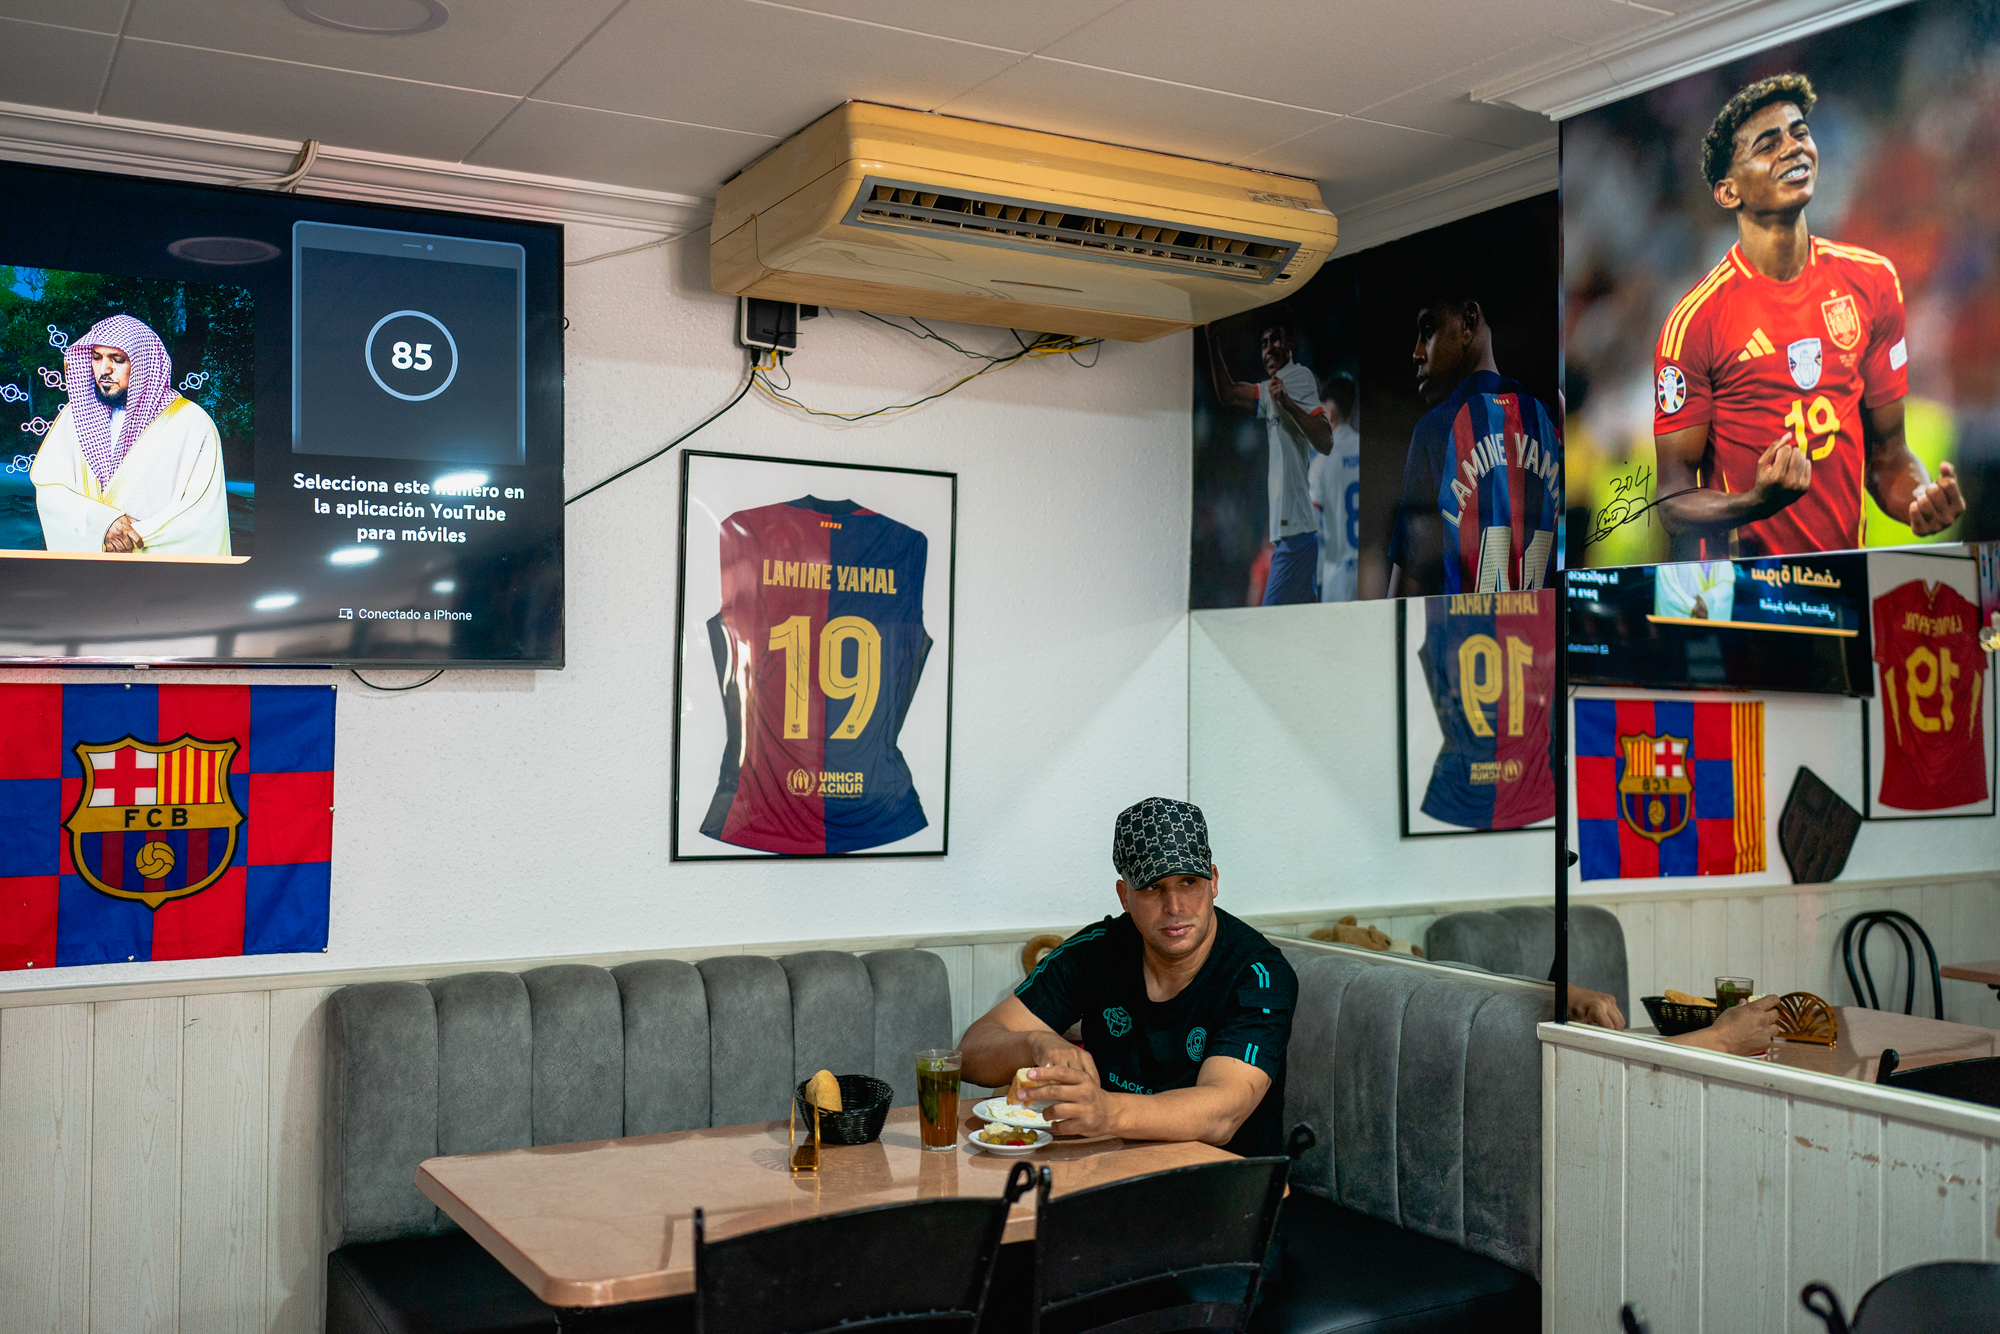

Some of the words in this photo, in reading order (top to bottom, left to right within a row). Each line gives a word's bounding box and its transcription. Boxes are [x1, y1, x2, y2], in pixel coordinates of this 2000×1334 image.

[391, 341, 433, 372] 85
[1784, 395, 1840, 461] 19
[293, 472, 389, 493] Selecciona
[393, 479, 431, 495] este
[504, 486, 525, 500] en
[1441, 433, 1508, 528] LAMINE
[313, 497, 331, 515] la
[336, 499, 426, 519] aplicación
[430, 502, 507, 522] YouTube
[357, 527, 396, 543] para
[401, 525, 467, 544] móviles
[762, 558, 833, 590] LAMINE
[836, 565, 898, 594] YAMAL
[358, 608, 421, 620] Conectado
[423, 611, 431, 620] a
[433, 609, 473, 621] iPhone
[768, 615, 882, 740] 19
[817, 782, 863, 794] ACNUR
[819, 771, 864, 783] UNHCR
[124, 807, 189, 828] FCB
[1109, 1072, 1144, 1094] BLACK
